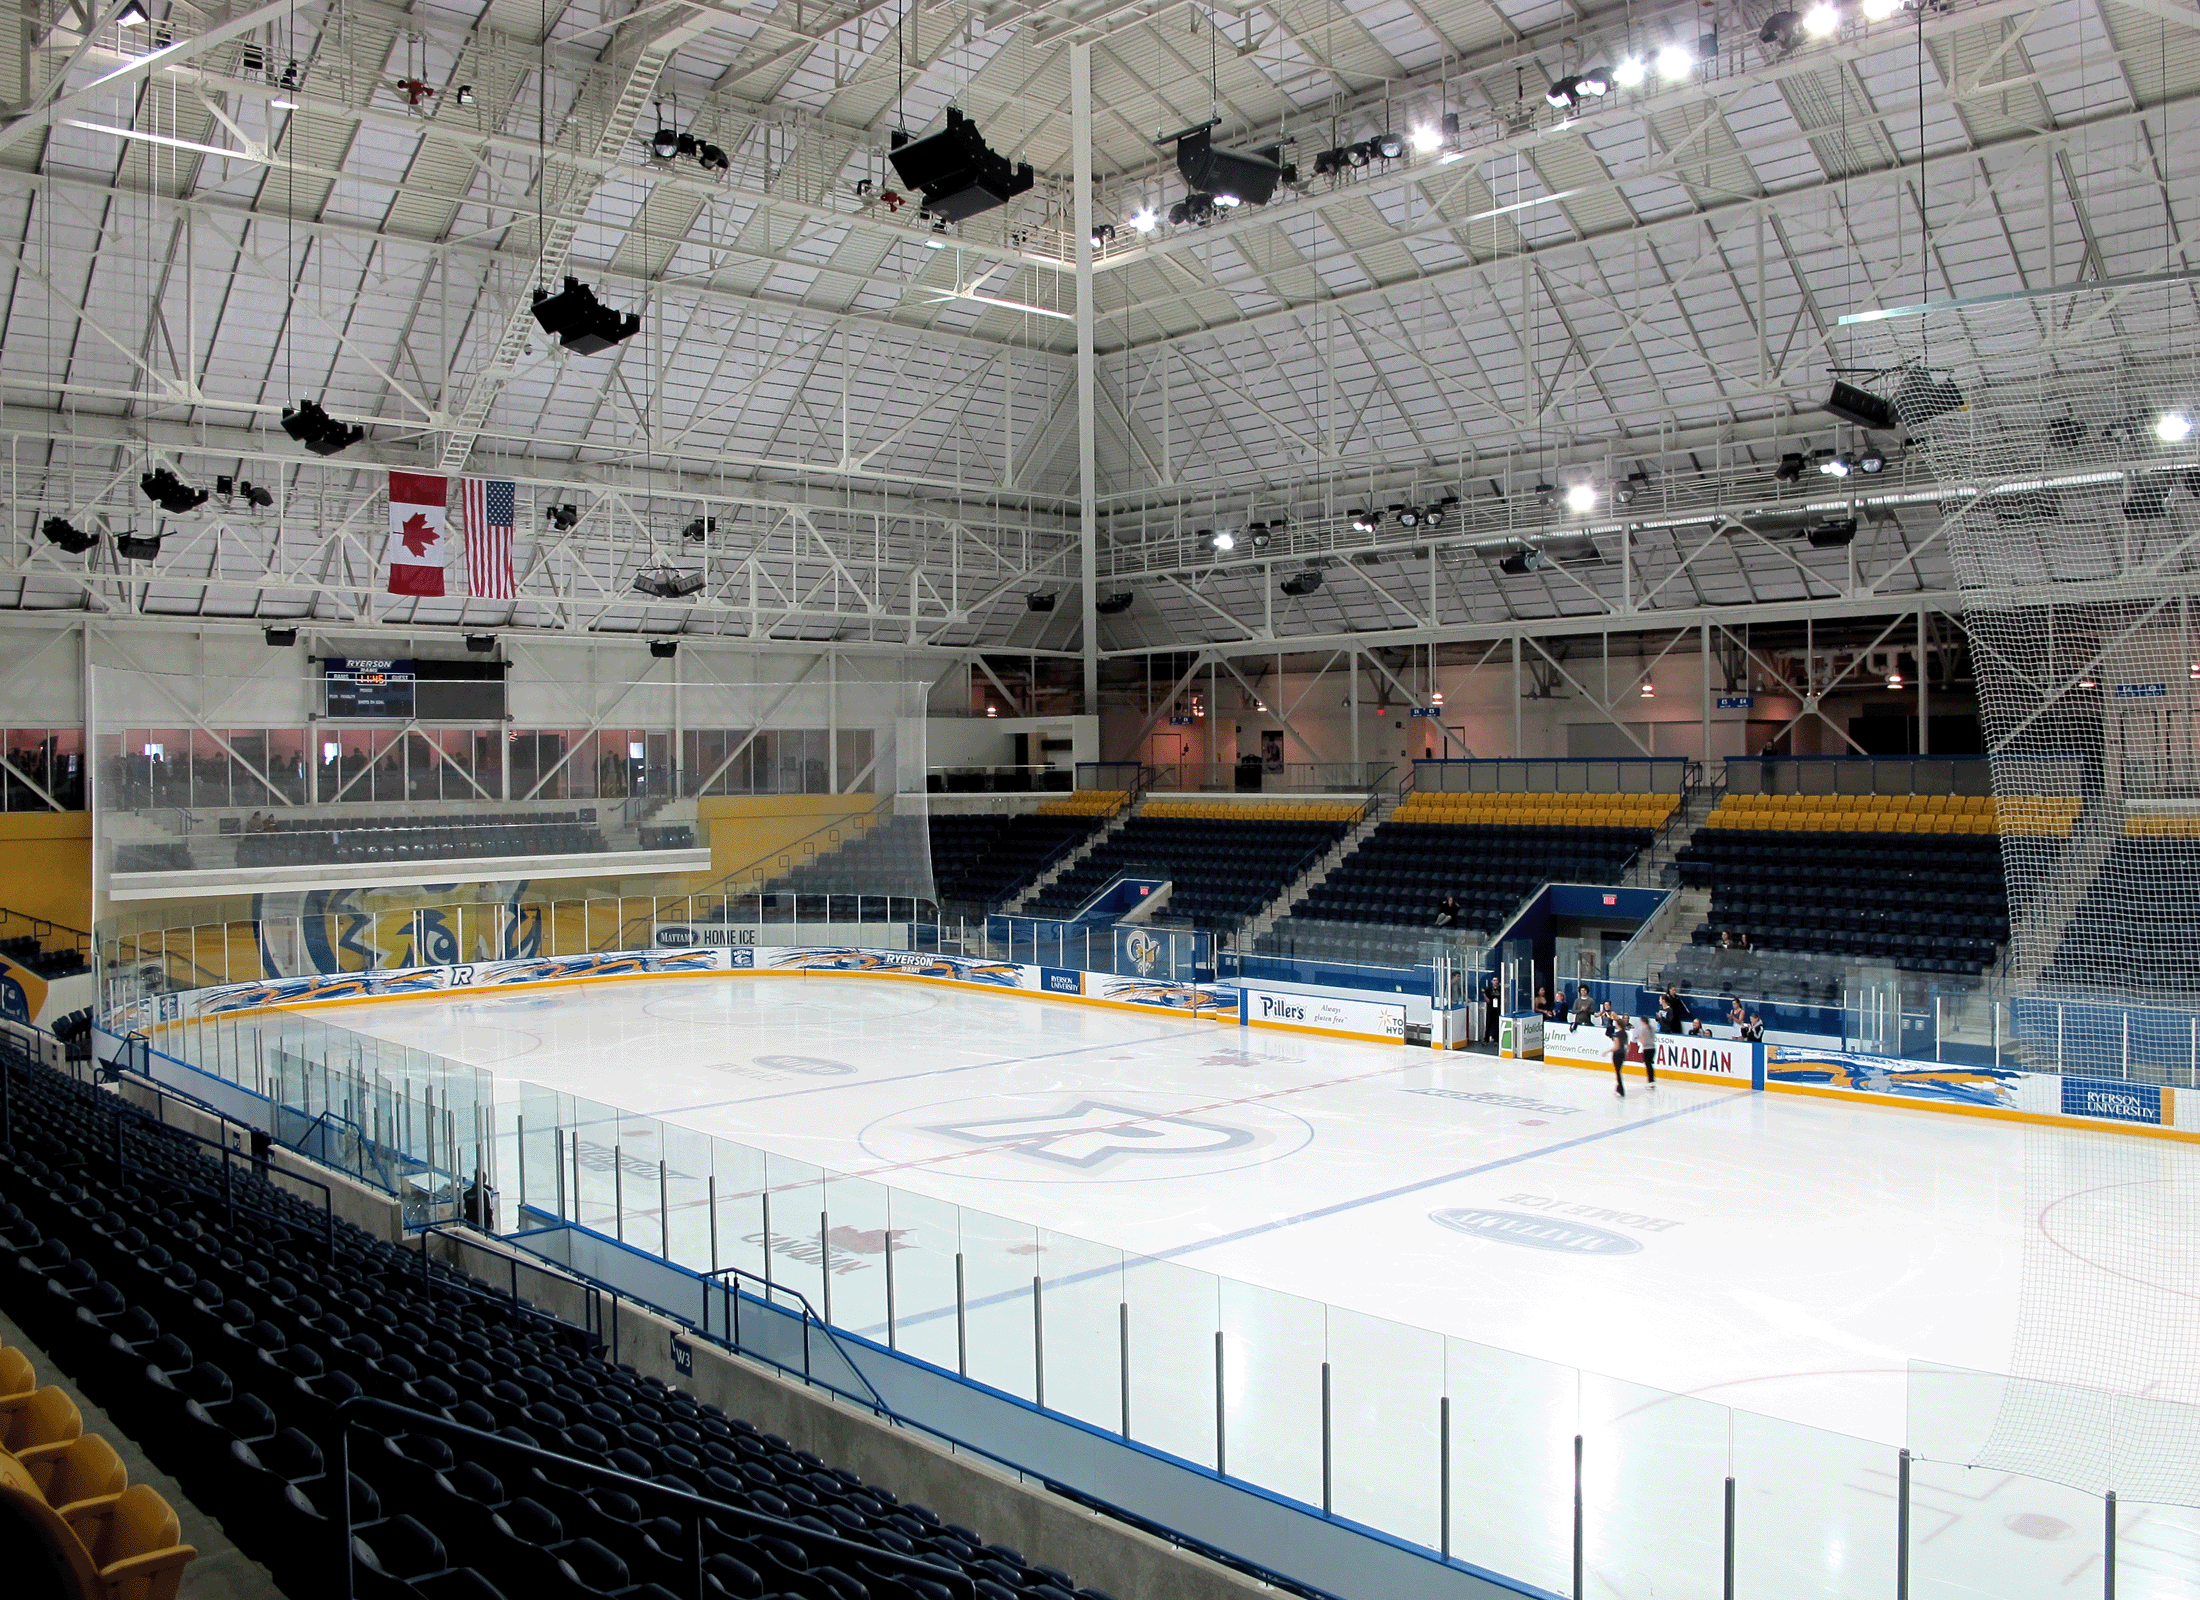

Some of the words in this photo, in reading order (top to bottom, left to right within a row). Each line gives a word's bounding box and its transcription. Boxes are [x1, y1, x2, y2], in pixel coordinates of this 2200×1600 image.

[346, 660, 393, 668] RYERSON
[704, 930, 736, 945] HOME
[740, 930, 755, 945] ICE
[886, 953, 934, 967] RYERSON
[901, 966, 920, 974] RAMS
[1050, 975, 1073, 984] RYERSON
[1050, 981, 1079, 992] UNIVERSITY
[1260, 996, 1305, 1021] Piller's
[1321, 1004, 1341, 1014] Always
[1314, 1014, 1332, 1022] gluten
[1392, 1018, 1404, 1027] TO
[1386, 1026, 1404, 1036] HYD
[1552, 1030, 1566, 1041] Inn
[1653, 1037, 1675, 1045] OLSON
[1577, 1046, 1599, 1056] Centre
[1652, 1044, 1732, 1073] ANADIAN
[2087, 1091, 2140, 1107] RYERSON
[2087, 1101, 2155, 1118] UNIVERSITY
[676, 1347, 691, 1368] W3
